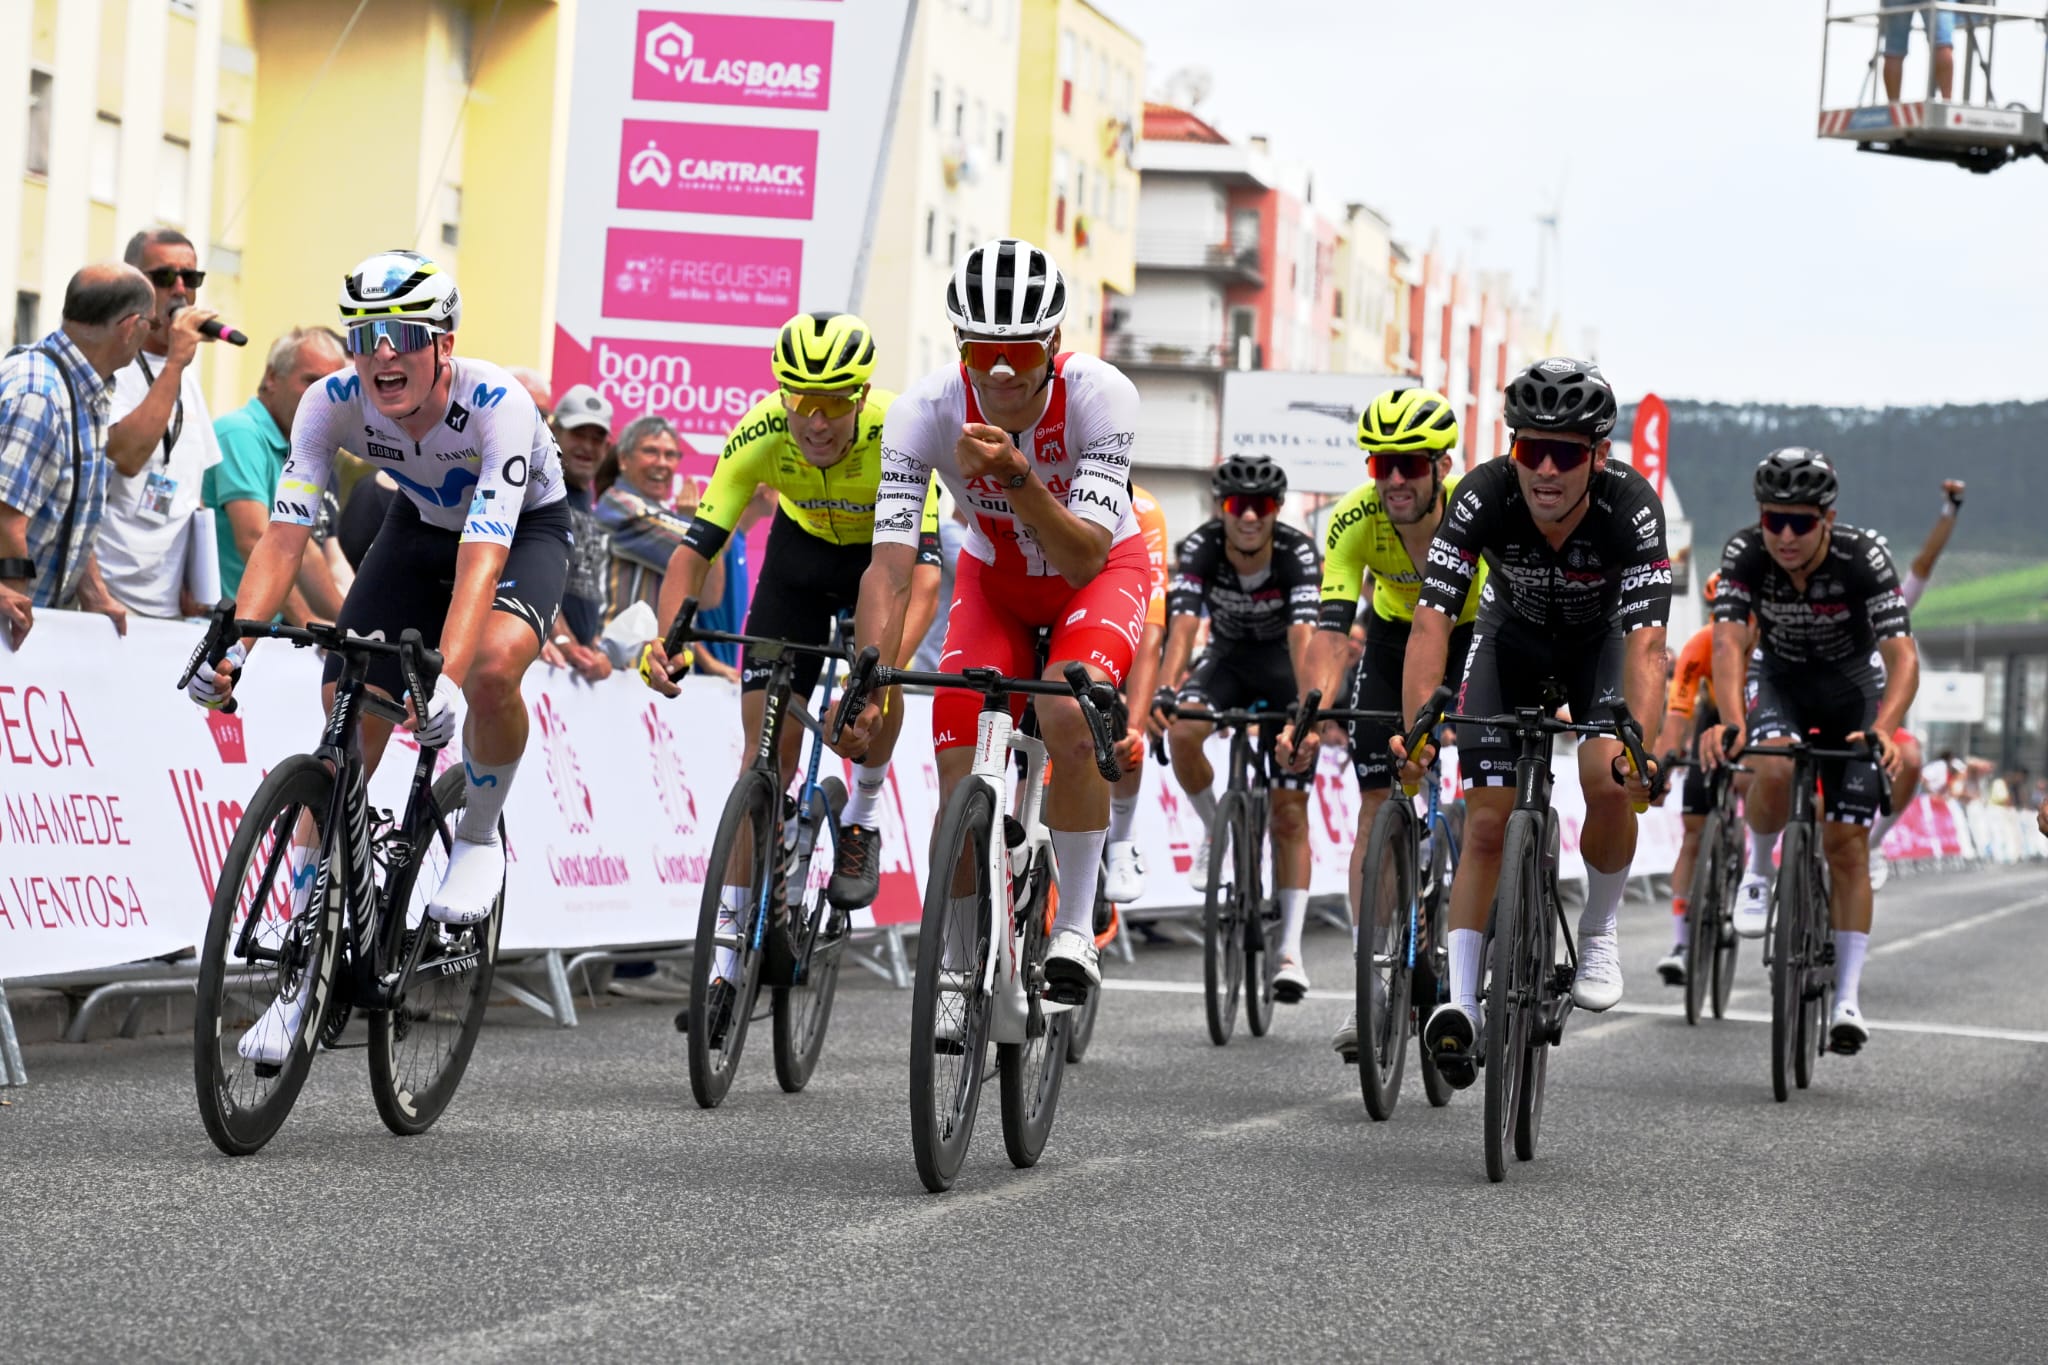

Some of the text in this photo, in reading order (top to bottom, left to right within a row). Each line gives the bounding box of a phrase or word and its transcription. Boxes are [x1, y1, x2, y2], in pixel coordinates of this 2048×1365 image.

[678, 158, 805, 186] CARTRACK
[669, 259, 793, 288] FREGUESIA
[598, 343, 691, 384] bom
[370, 444, 401, 461] GOBIK
[436, 446, 478, 461] CANYON
[1069, 488, 1120, 517] FIAAL
[0, 685, 94, 768] EGA
[760, 694, 779, 758] FACTOR
[984, 720, 994, 763] ORBEA
[5, 792, 131, 846] MAMEDE
[10, 875, 148, 929] VENTOSA
[302, 856, 331, 946] CANYON
[441, 956, 478, 976] CANYON
